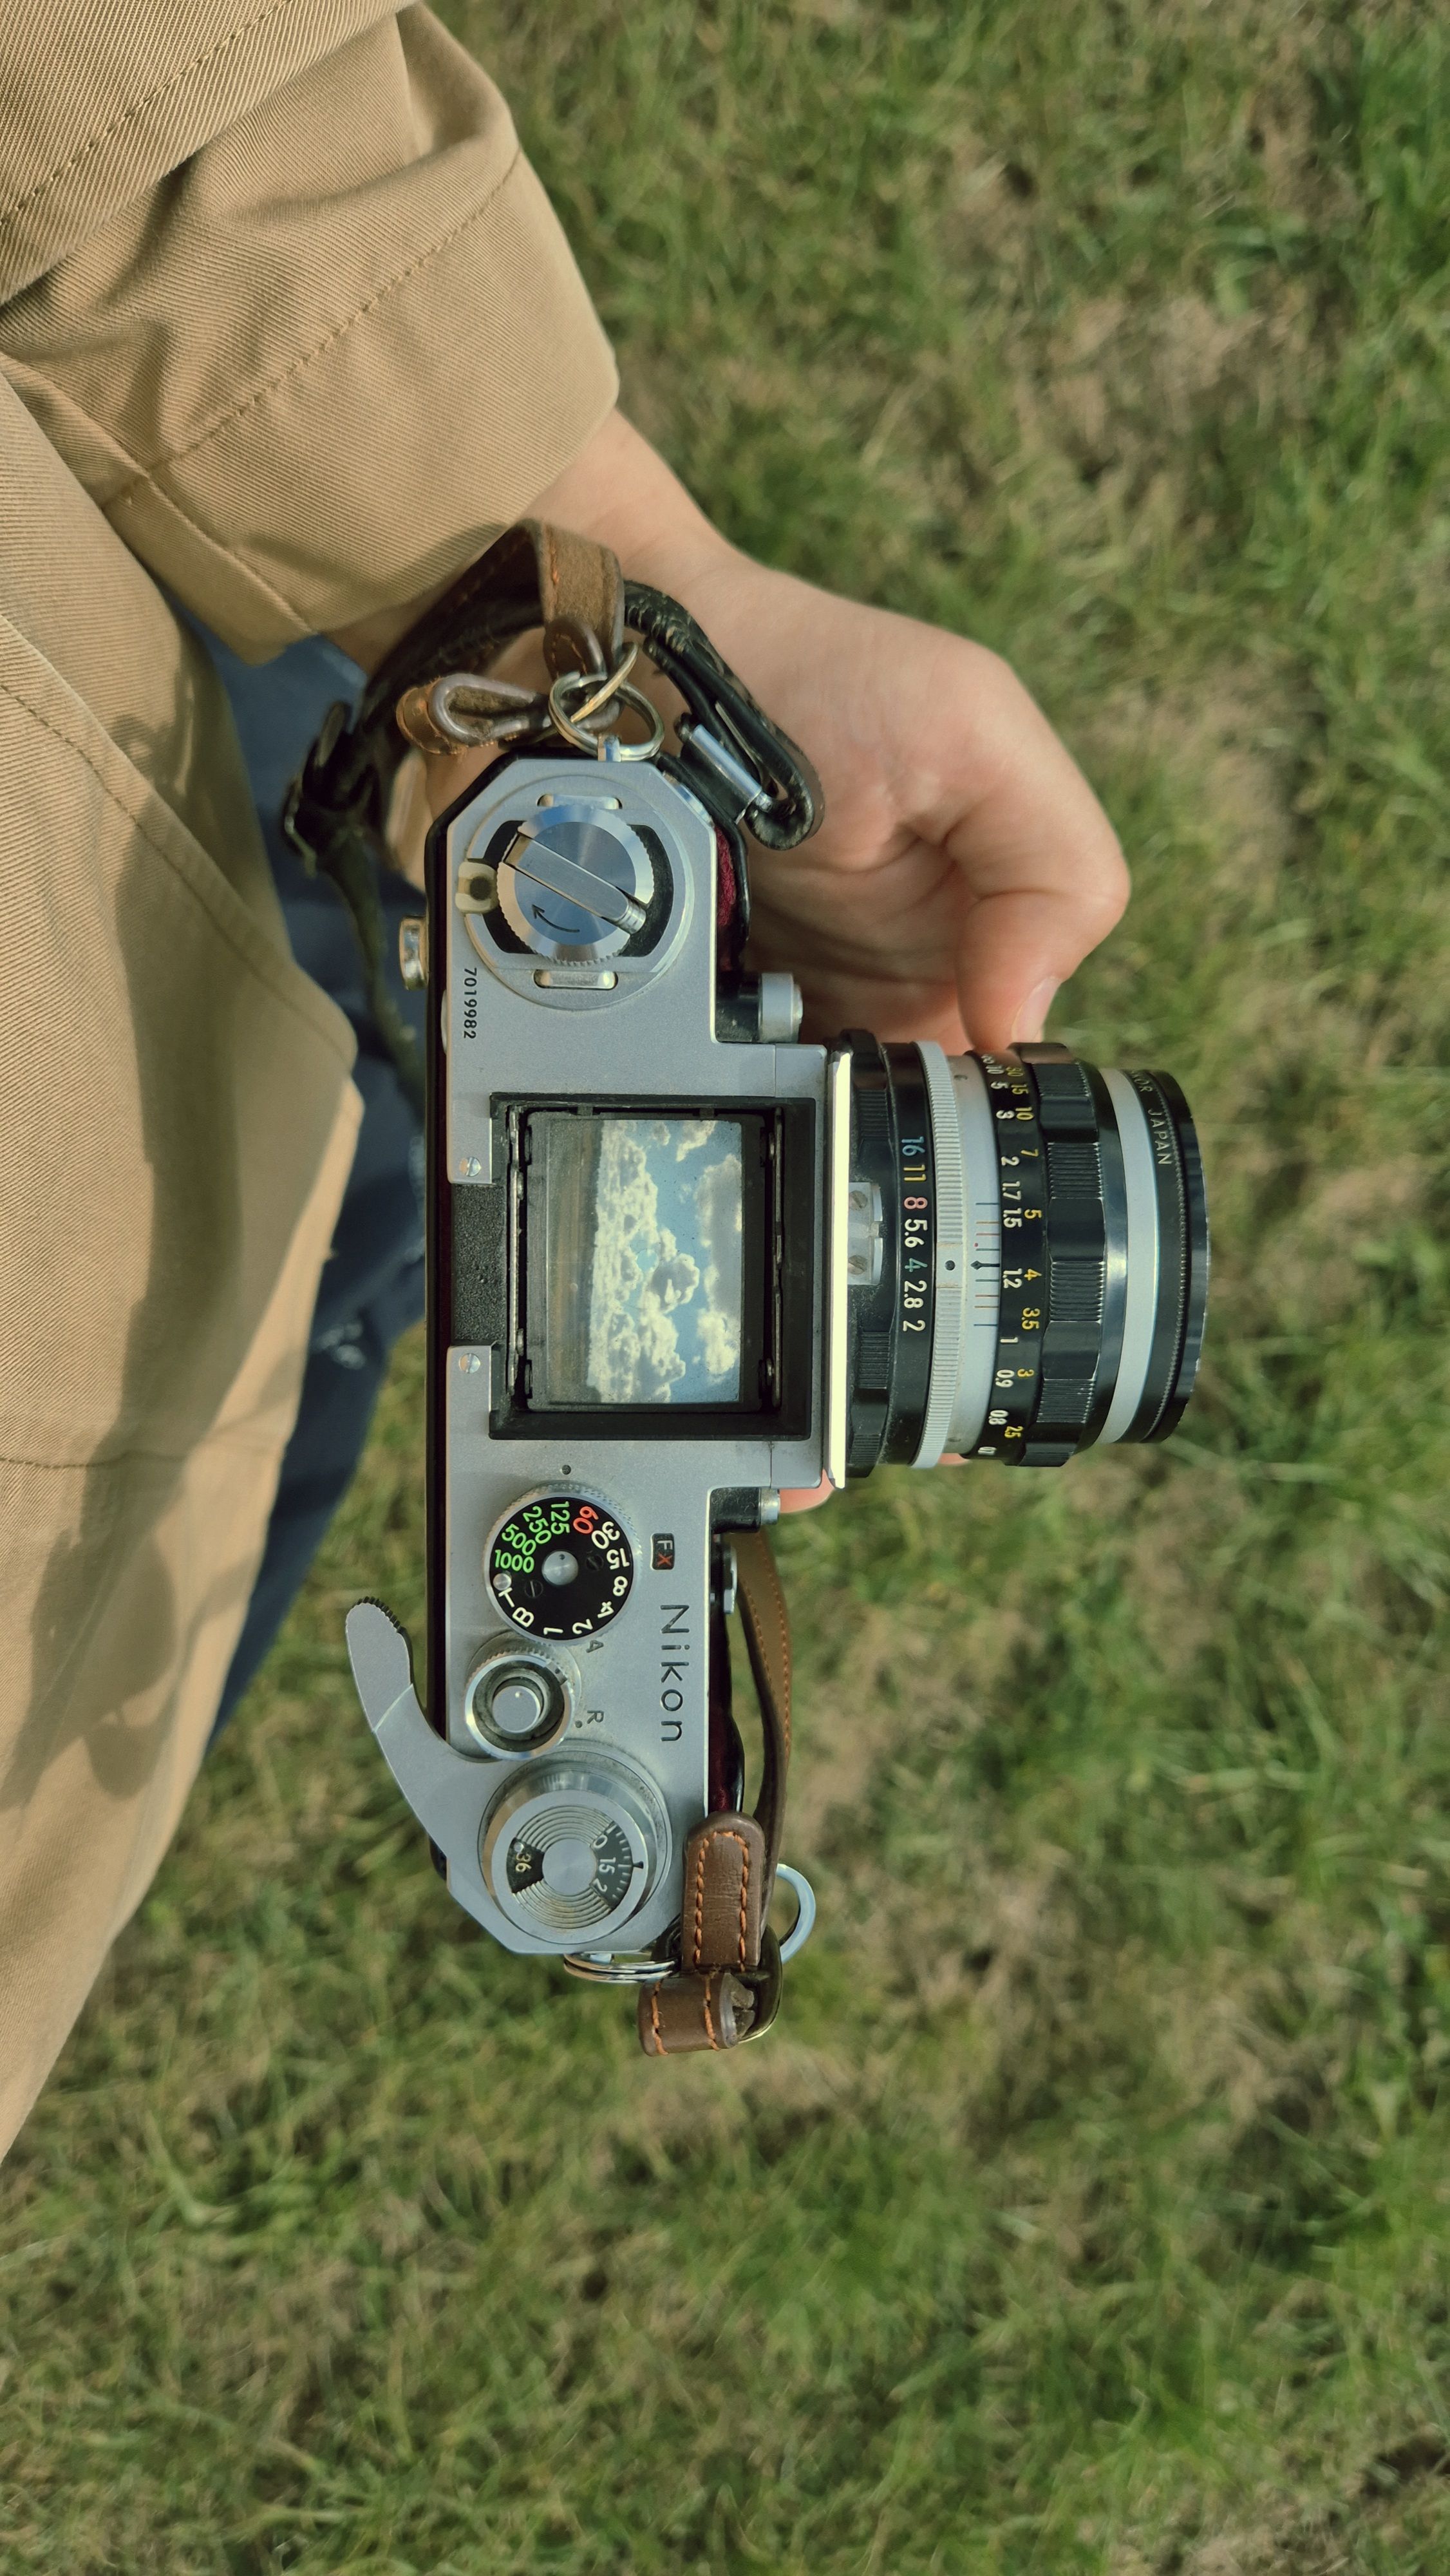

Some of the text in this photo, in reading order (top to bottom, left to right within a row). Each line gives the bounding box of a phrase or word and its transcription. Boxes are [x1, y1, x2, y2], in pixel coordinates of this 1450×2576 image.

[464, 967, 478, 1039] 7019982
[985, 1065, 1004, 1074] 10
[990, 1081, 1009, 1090] 5
[1010, 1083, 1030, 1095] 15
[995, 1110, 1015, 1119] 3
[1015, 1106, 1034, 1121] 10
[1148, 1108, 1174, 1165] JAPAN
[1020, 1148, 1039, 1157] 7
[1001, 1157, 1019, 1166] 2
[1002, 1180, 1021, 1200] 1.7
[1003, 1208, 1022, 1228] 1.5
[1024, 1209, 1042, 1220] 5
[901, 1135, 928, 1332] 16 11 8 5.6 4 2.8 2
[1003, 1268, 1022, 1289] 1.2
[1024, 1268, 1042, 1281] 4
[1021, 1307, 1040, 1330] 3.5
[995, 1369, 1015, 1388] 0.9
[1016, 1368, 1035, 1378] 3
[988, 1409, 1008, 1425] 0.8
[656, 1539, 673, 1566] FX
[494, 1501, 630, 1635] 1000 500 250 125 60 30 15 8 4 2 1 B T
[586, 1640, 605, 1653] A
[659, 1604, 690, 1741] Nikon
[587, 1710, 604, 1724] R
[592, 1834, 608, 1849] 0
[515, 1852, 532, 1873] 36
[598, 1857, 616, 1875] 15
